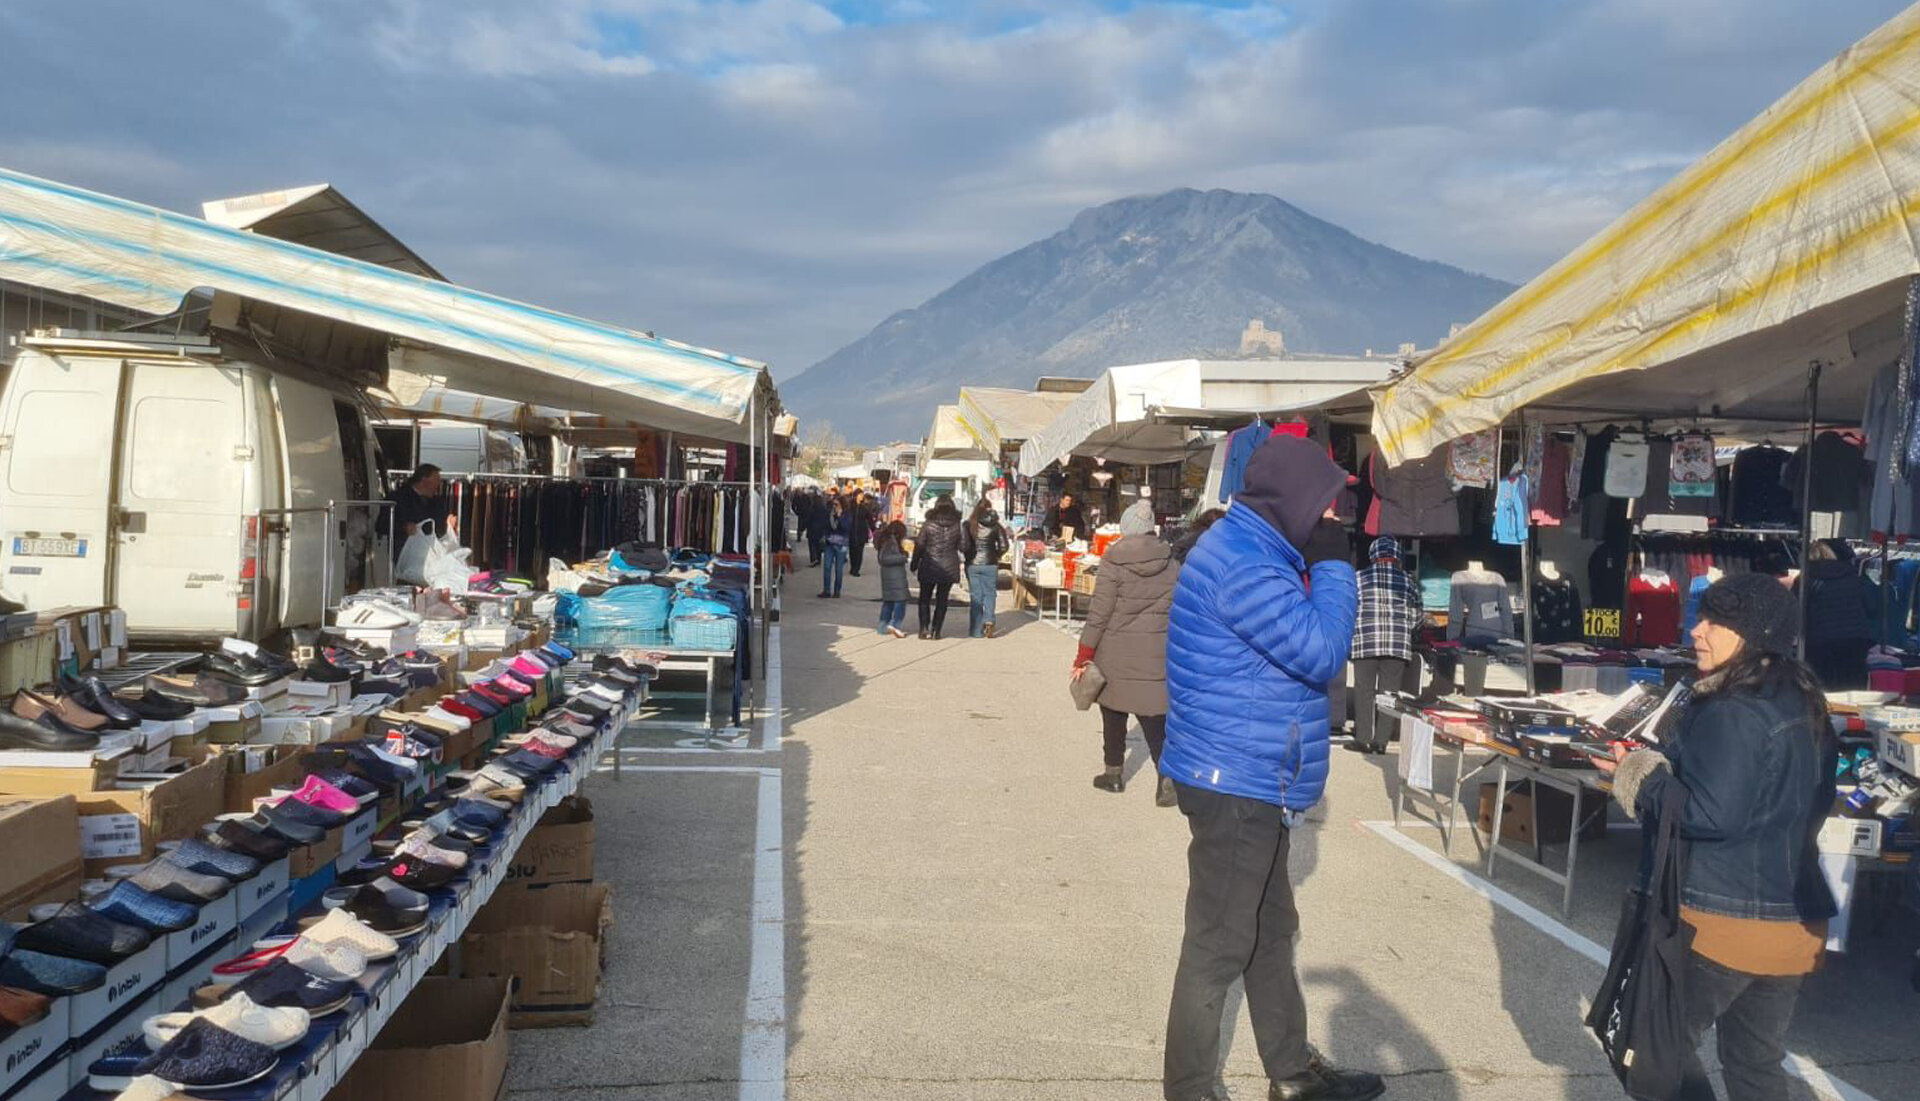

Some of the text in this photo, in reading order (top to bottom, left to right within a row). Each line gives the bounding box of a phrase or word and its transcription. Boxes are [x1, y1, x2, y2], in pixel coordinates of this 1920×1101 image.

[1886, 737, 1906, 764] FILA
[117, 972, 141, 997] inblu
[16, 1036, 42, 1066] inblu
